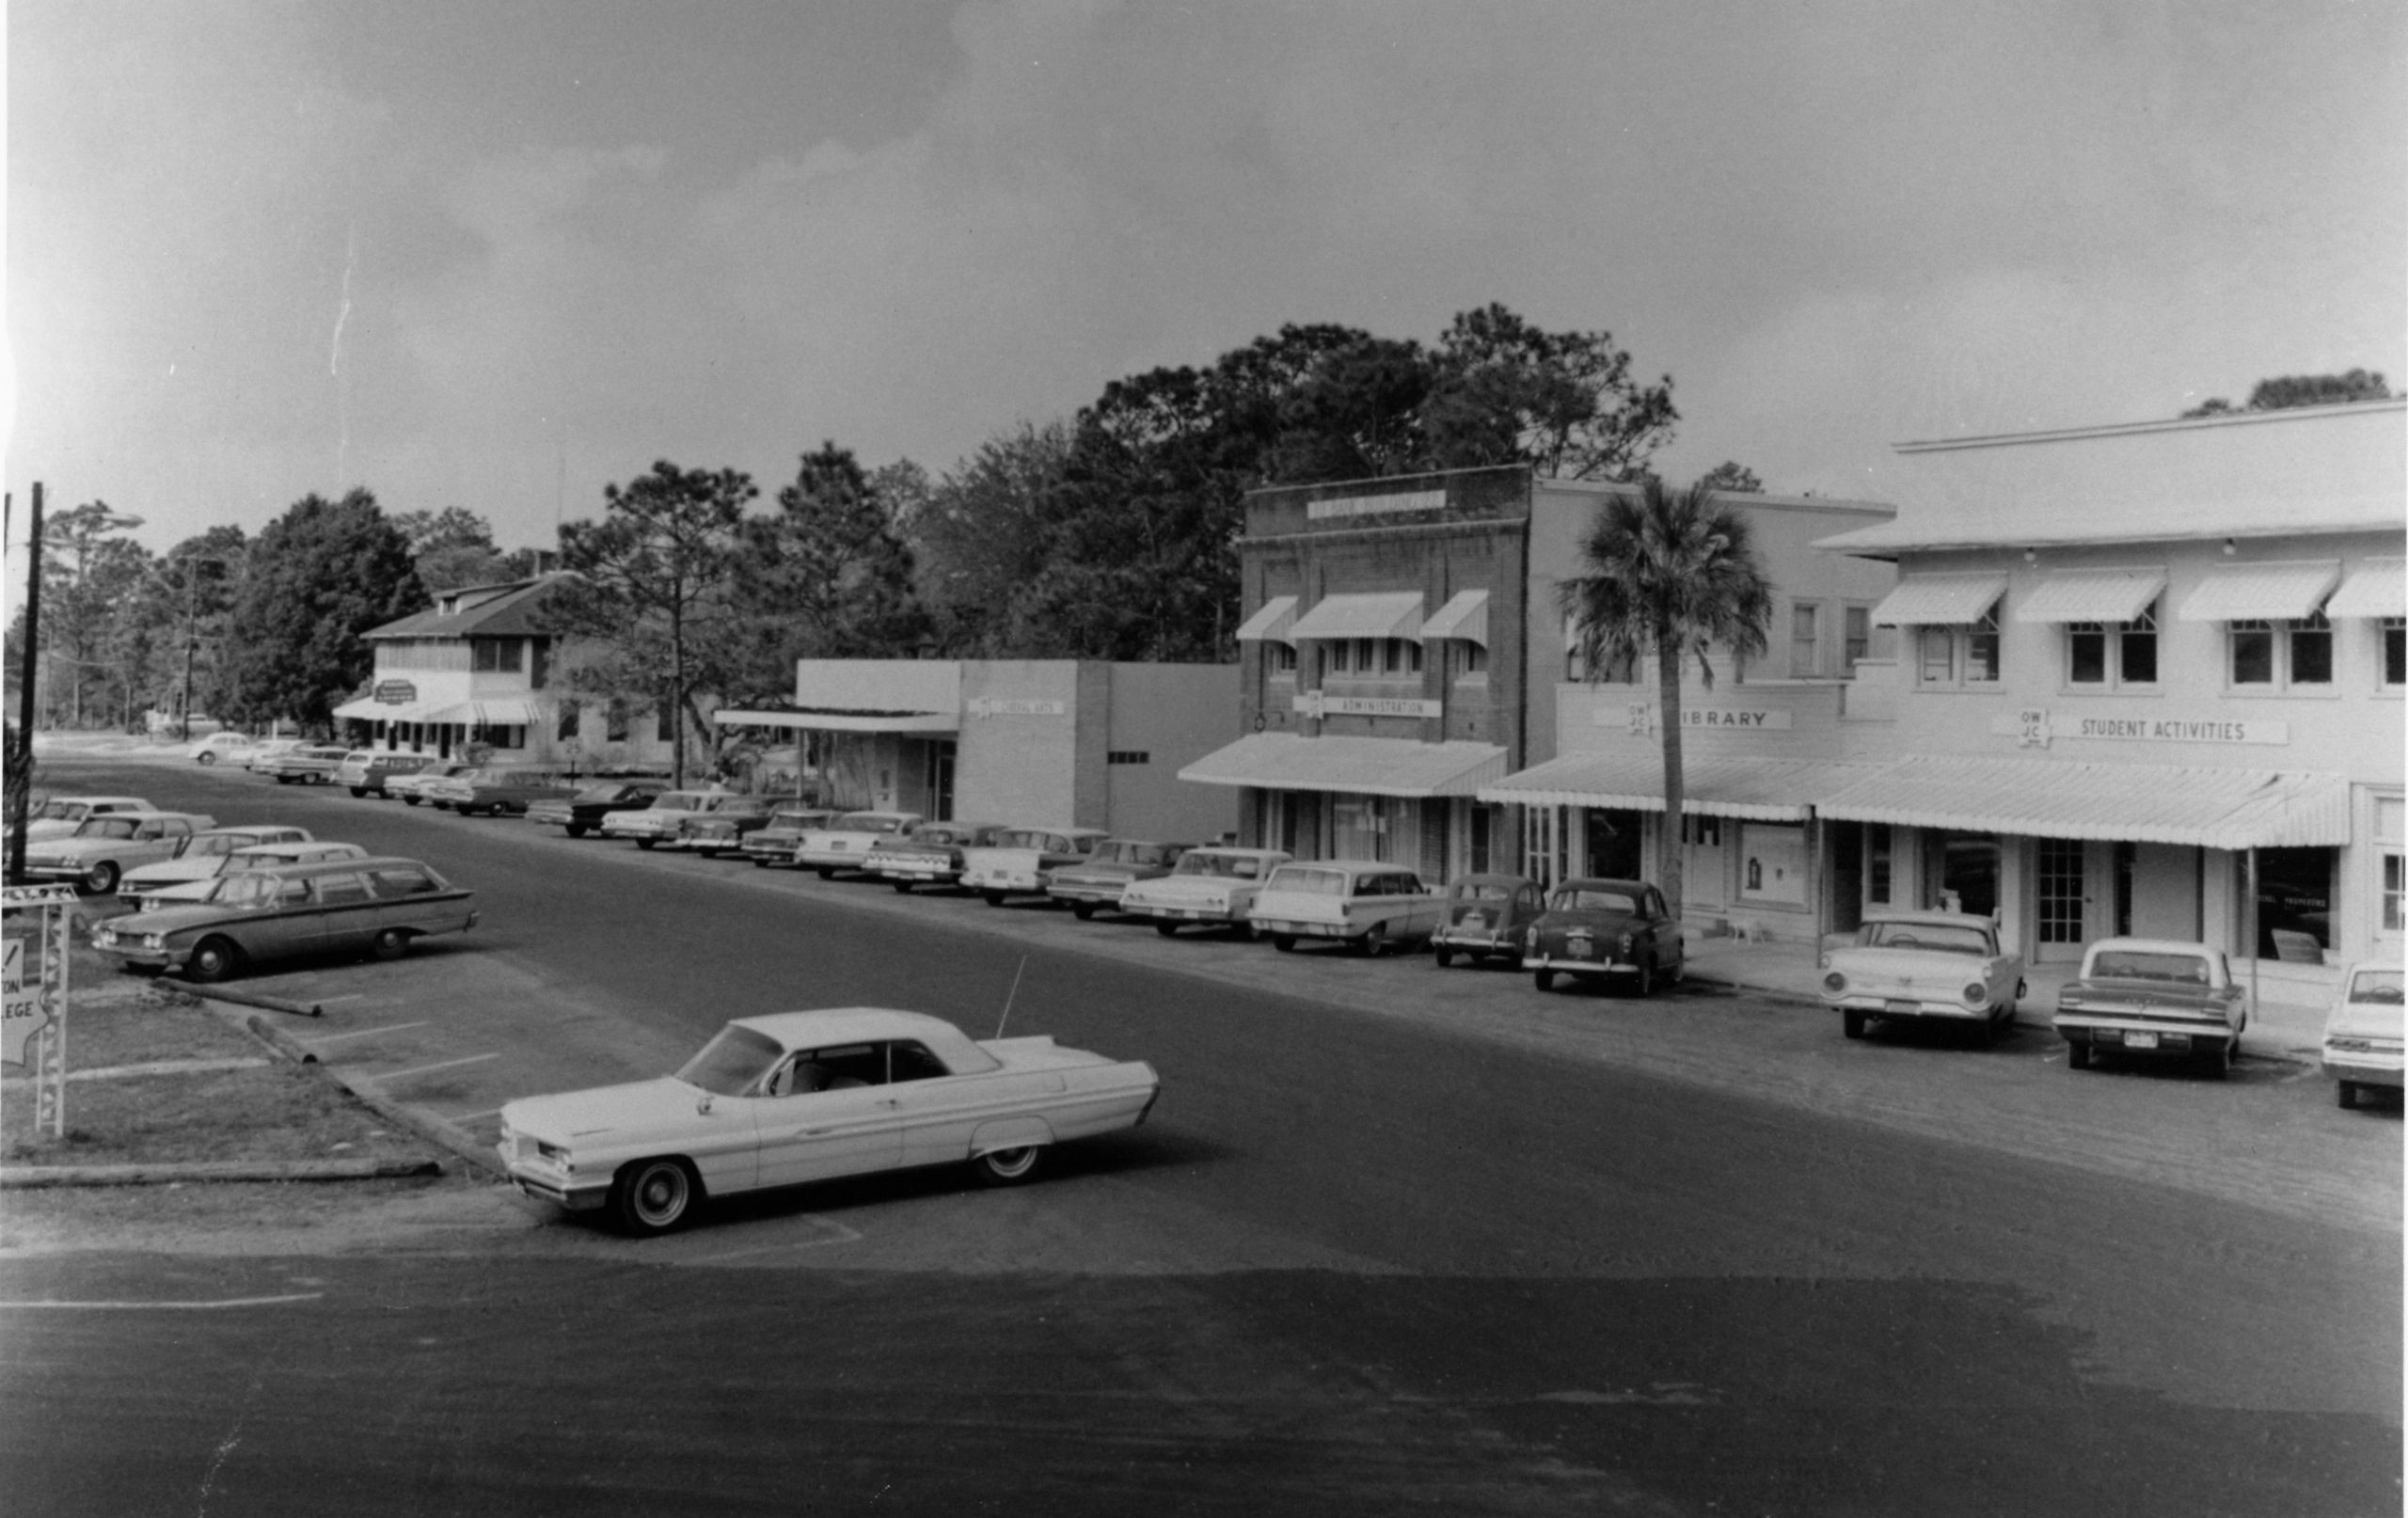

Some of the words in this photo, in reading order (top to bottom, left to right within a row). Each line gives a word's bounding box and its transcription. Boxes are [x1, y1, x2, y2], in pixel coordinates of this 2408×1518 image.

[1342, 699, 1423, 714] ADMINISTRATION
[1682, 711, 1766, 726] IBRARY
[2021, 711, 2041, 723] OW
[2021, 726, 2040, 737] JC
[2082, 719, 2147, 736] STUDENT
[2153, 721, 2244, 740] ACTIVITIES
[566, 742, 581, 753] 25
[2, 979, 19, 994] ON
